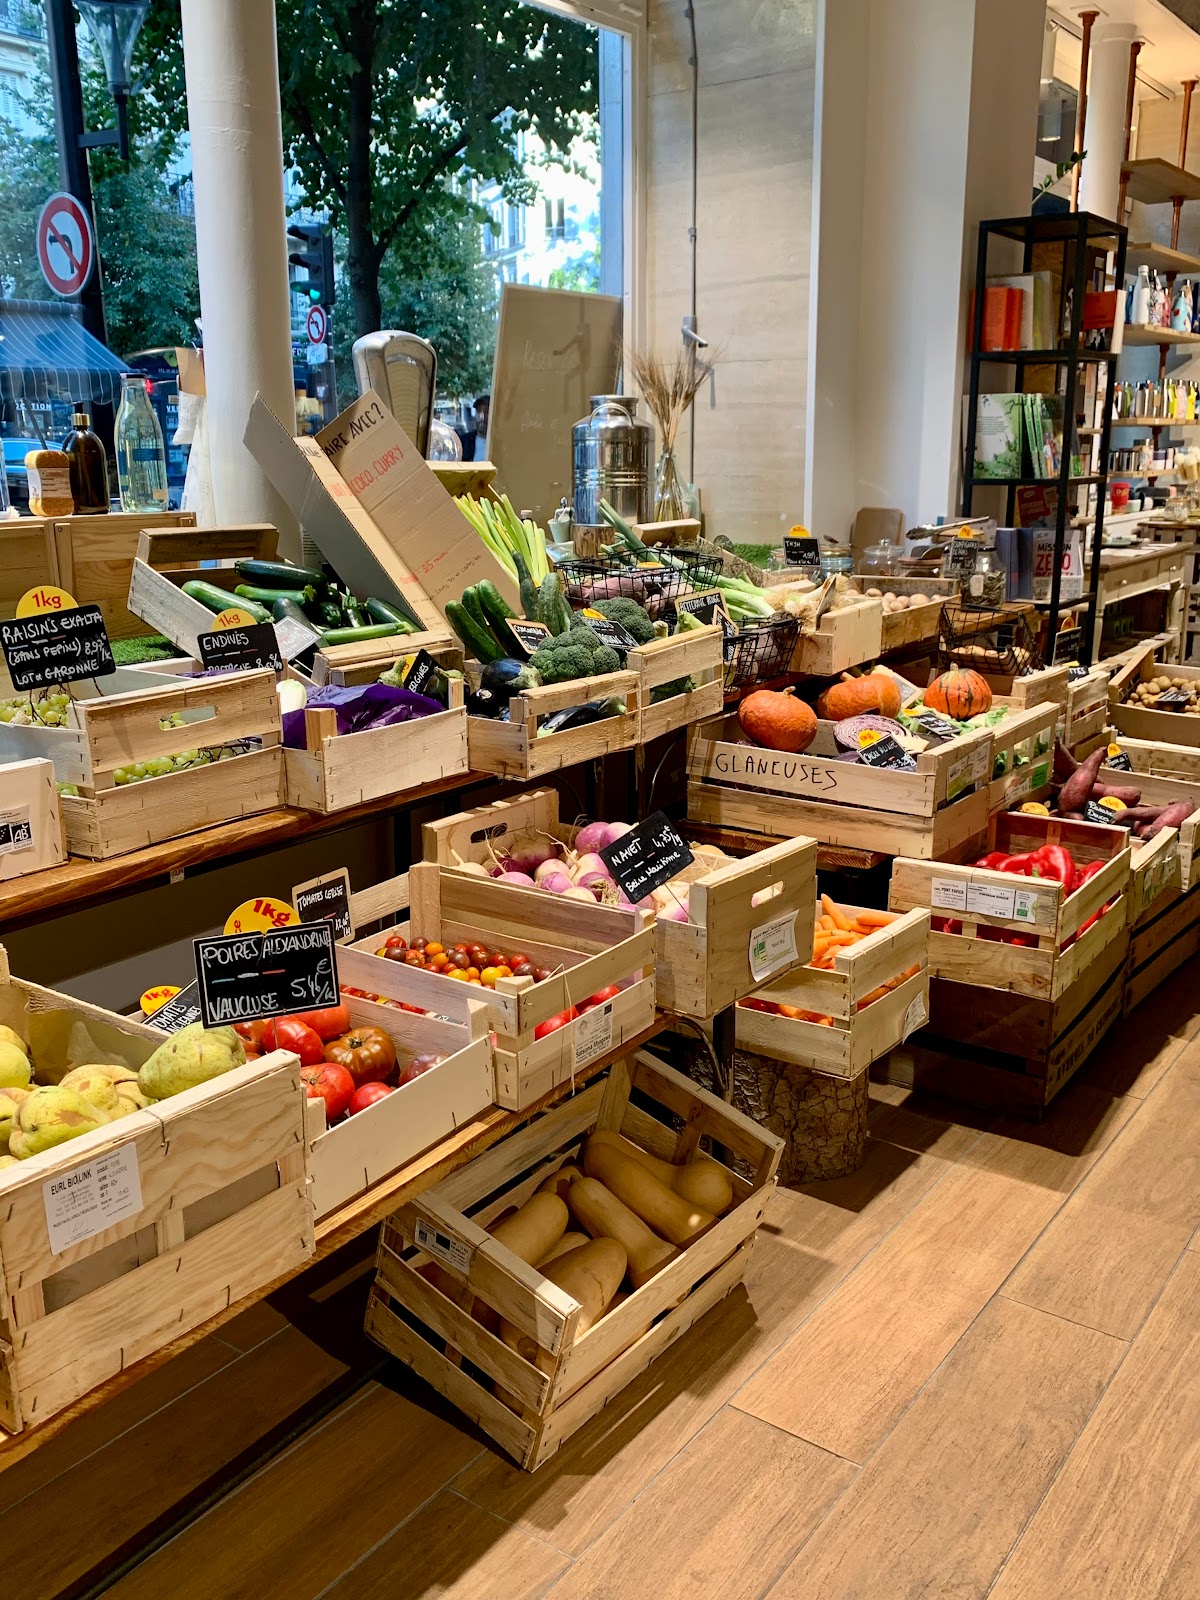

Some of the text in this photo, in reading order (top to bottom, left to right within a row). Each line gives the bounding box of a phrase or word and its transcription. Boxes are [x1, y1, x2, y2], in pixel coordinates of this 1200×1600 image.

[322, 432, 350, 458] AIRE
[349, 411, 377, 439] AVEC
[372, 444, 404, 476] CURRY
[1038, 543, 1072, 552] MISSON
[32, 590, 62, 609] 1kg
[2, 619, 58, 644] RAISINS
[218, 613, 241, 628] 1kg
[202, 631, 250, 651] ENDIVES
[45, 659, 99, 680] GARONNE
[408, 662, 430, 693] ERGINES
[715, 753, 838, 791] GLANEUSES
[611, 837, 642, 867] NAVET
[253, 899, 292, 927] 1kg
[297, 890, 324, 911] TOMATES
[203, 938, 260, 968] POIRES
[143, 988, 175, 1001] 1kg
[209, 992, 279, 1021] VAUCLUSE
[51, 1181, 67, 1196] EURL
